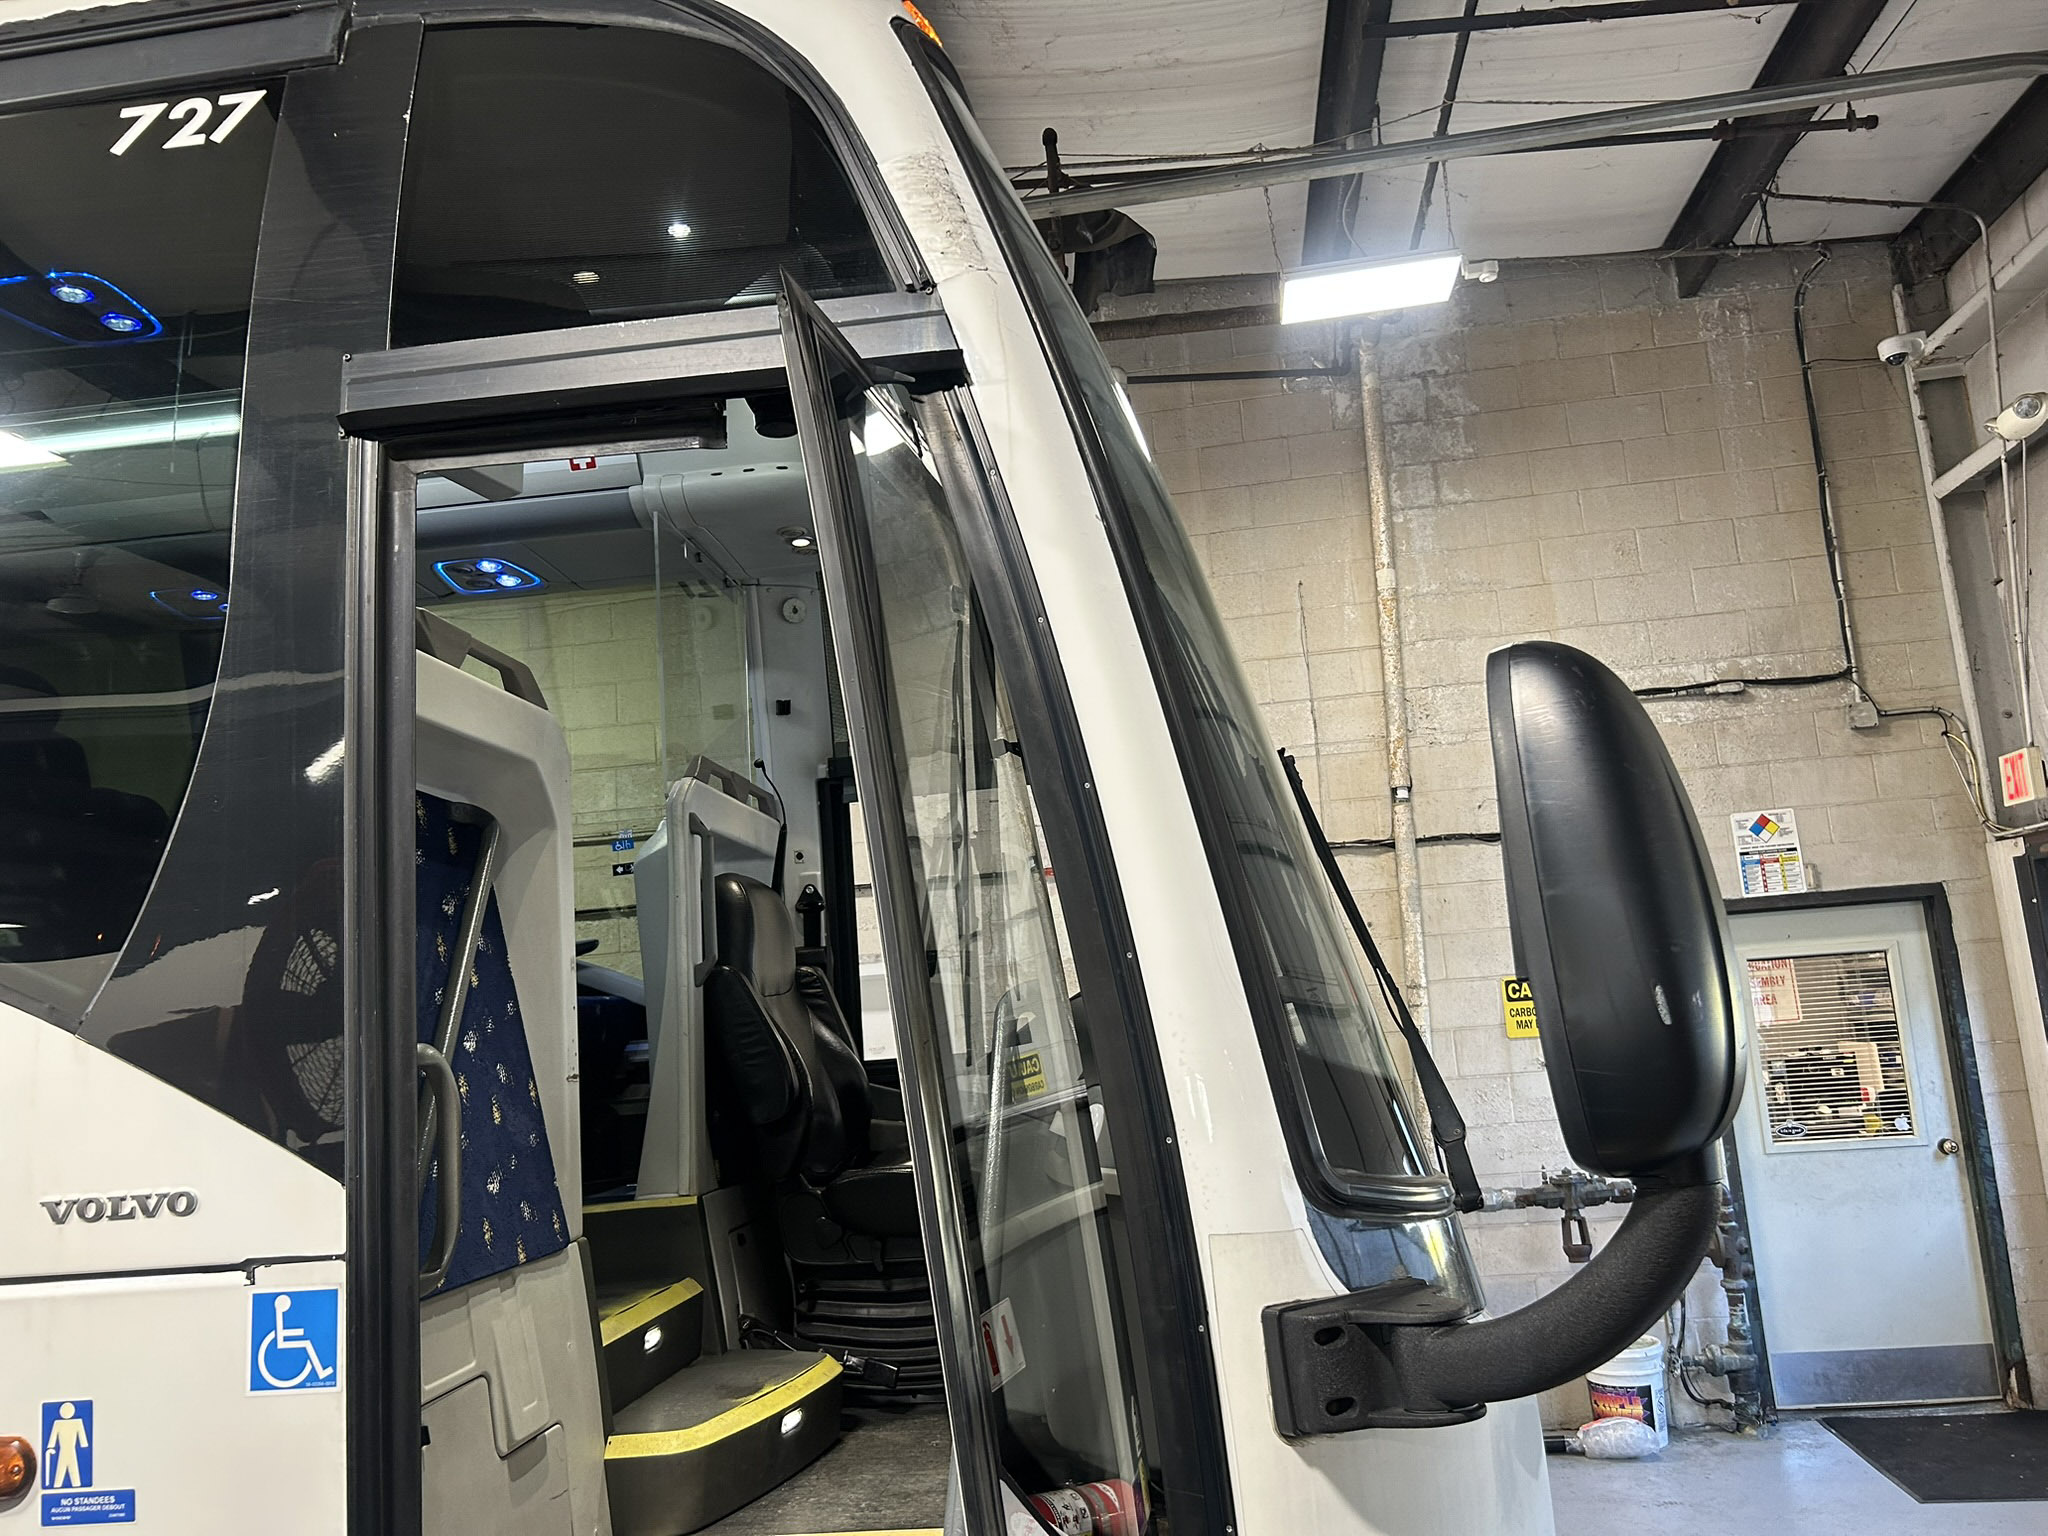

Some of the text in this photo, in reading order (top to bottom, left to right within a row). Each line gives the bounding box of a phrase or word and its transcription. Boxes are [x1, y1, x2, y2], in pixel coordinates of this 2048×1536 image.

[109, 89, 267, 156] 727
[2004, 753, 2029, 801] EXIT
[1508, 982, 1533, 999] CA
[1509, 1007, 1536, 1017] CARBO
[1516, 1019, 1533, 1029] MAY
[40, 1190, 198, 1224] VOLVO
[60, 1495, 115, 1506] NO STANDEES
